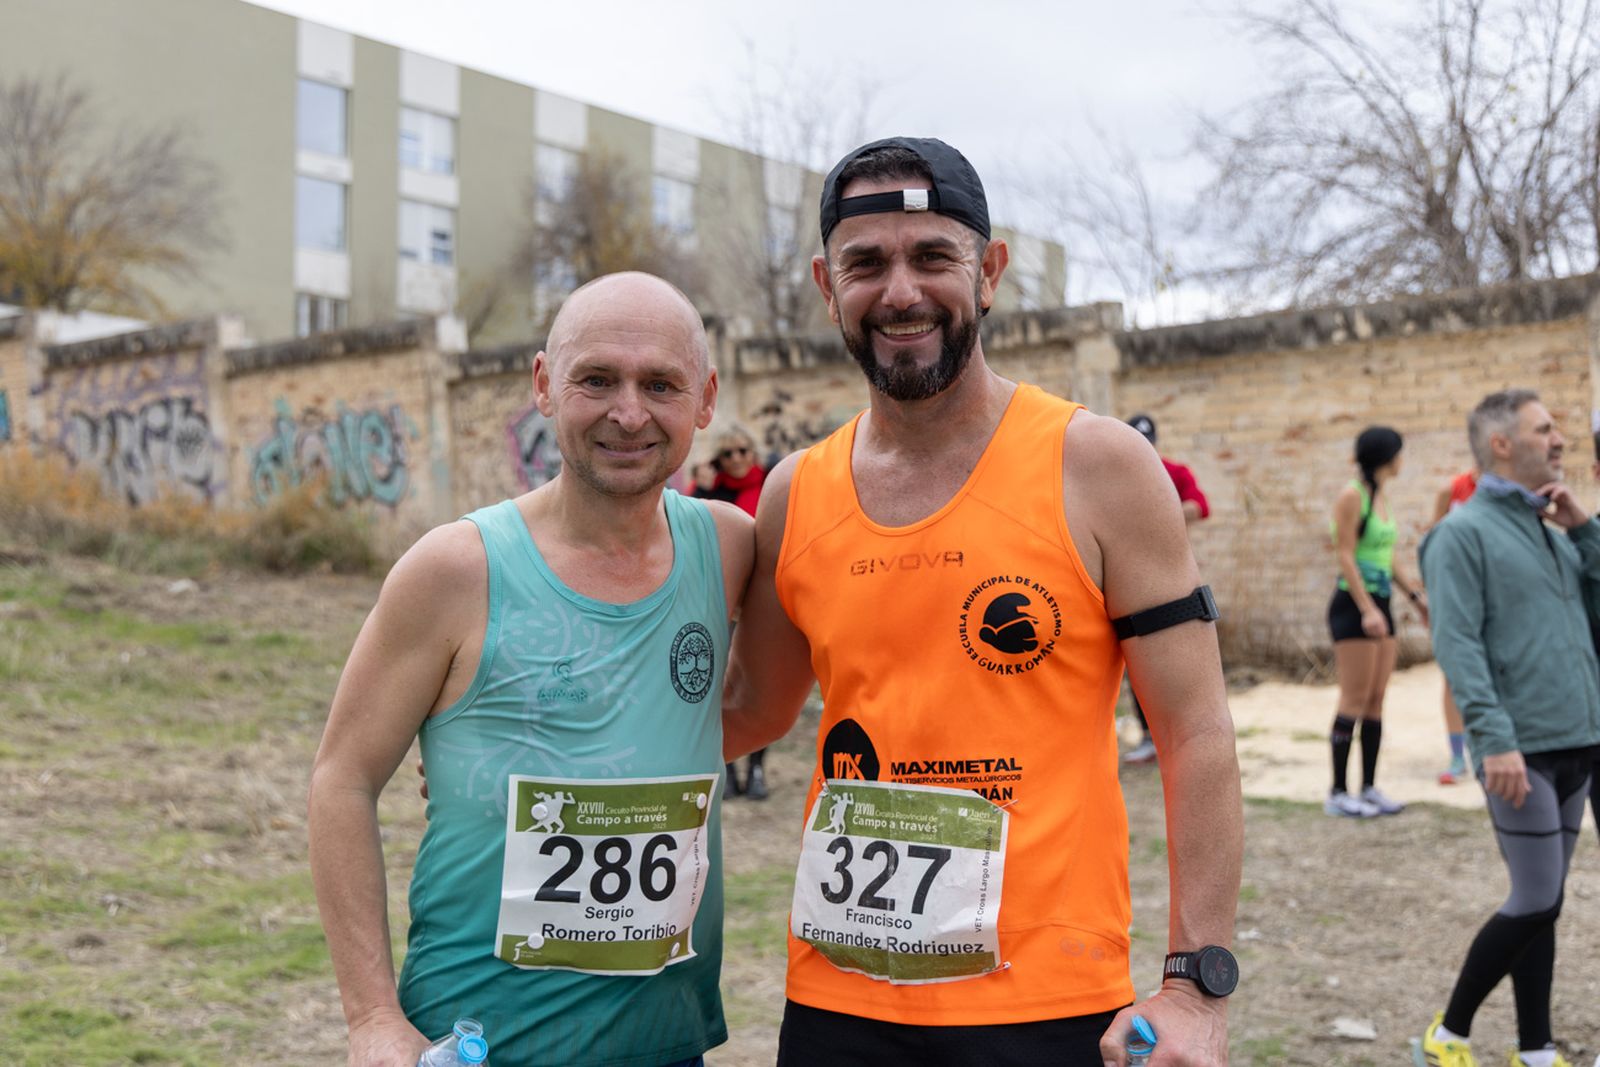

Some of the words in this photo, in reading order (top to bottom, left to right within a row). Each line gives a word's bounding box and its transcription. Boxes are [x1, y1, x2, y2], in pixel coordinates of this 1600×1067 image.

[850, 551, 963, 576] GIVOVA
[1015, 575, 1031, 586] DE
[962, 575, 1012, 611] MUNICIPAL
[1031, 583, 1062, 637] ATLETISMO
[959, 613, 979, 661] ESCUELA
[891, 758, 1022, 776] MAXIMETAL
[577, 801, 605, 815] XXVIII
[605, 806, 630, 815] Circuito
[631, 804, 659, 814] Provincial
[659, 804, 668, 812] de
[854, 801, 876, 816] XXVIII
[928, 815, 938, 823] de
[576, 814, 621, 828] Campo
[634, 812, 668, 823] través
[852, 815, 887, 829] Campo
[889, 820, 896, 829] a
[900, 820, 938, 833] través
[534, 833, 678, 904] 286
[820, 836, 952, 915] 327
[980, 868, 990, 891] Largo
[585, 905, 634, 922] Sergio
[976, 892, 986, 916] Cross
[846, 908, 912, 930] Francisco
[541, 923, 616, 942] Romero
[623, 923, 677, 941] Toribio
[802, 922, 882, 949] Fernandez
[887, 936, 984, 957] Rodriguez
